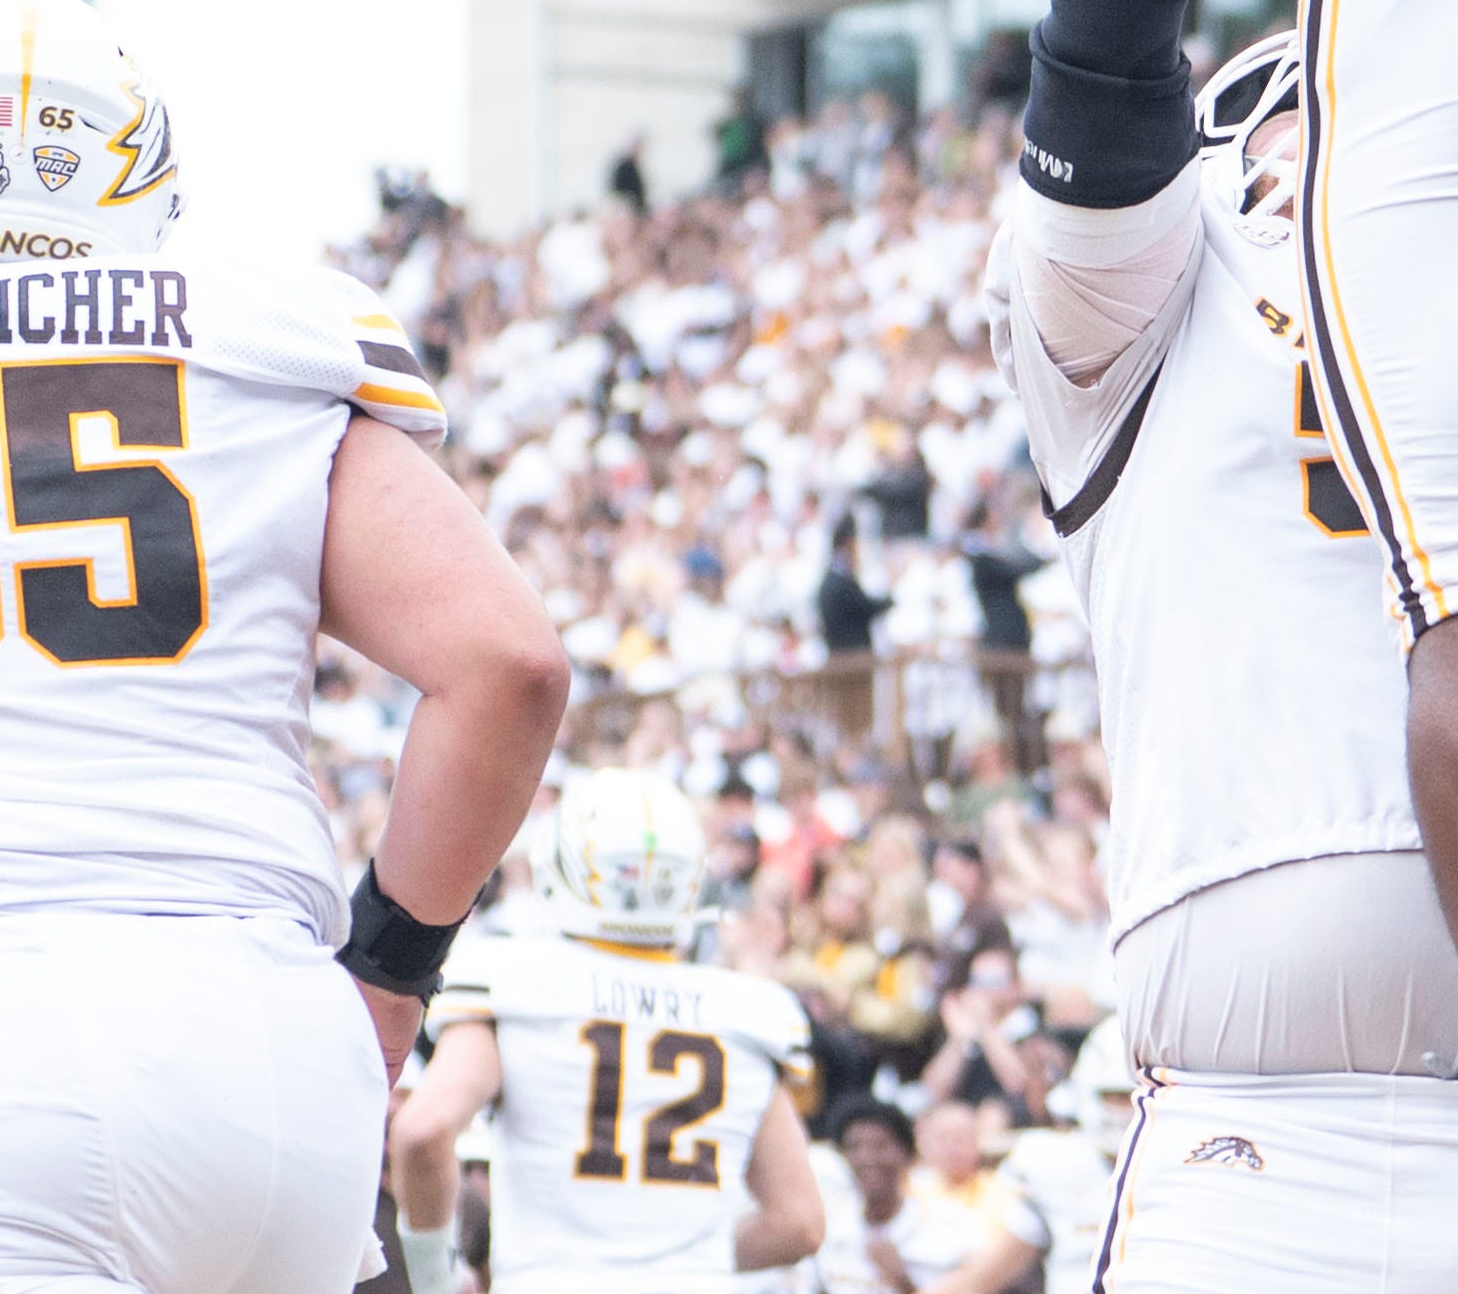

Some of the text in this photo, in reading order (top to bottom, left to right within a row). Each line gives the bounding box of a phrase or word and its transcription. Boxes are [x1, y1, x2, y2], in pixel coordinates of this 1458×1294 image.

[38, 105, 76, 131] 65
[36, 157, 78, 174] MAC
[574, 1020, 728, 1189] 12
